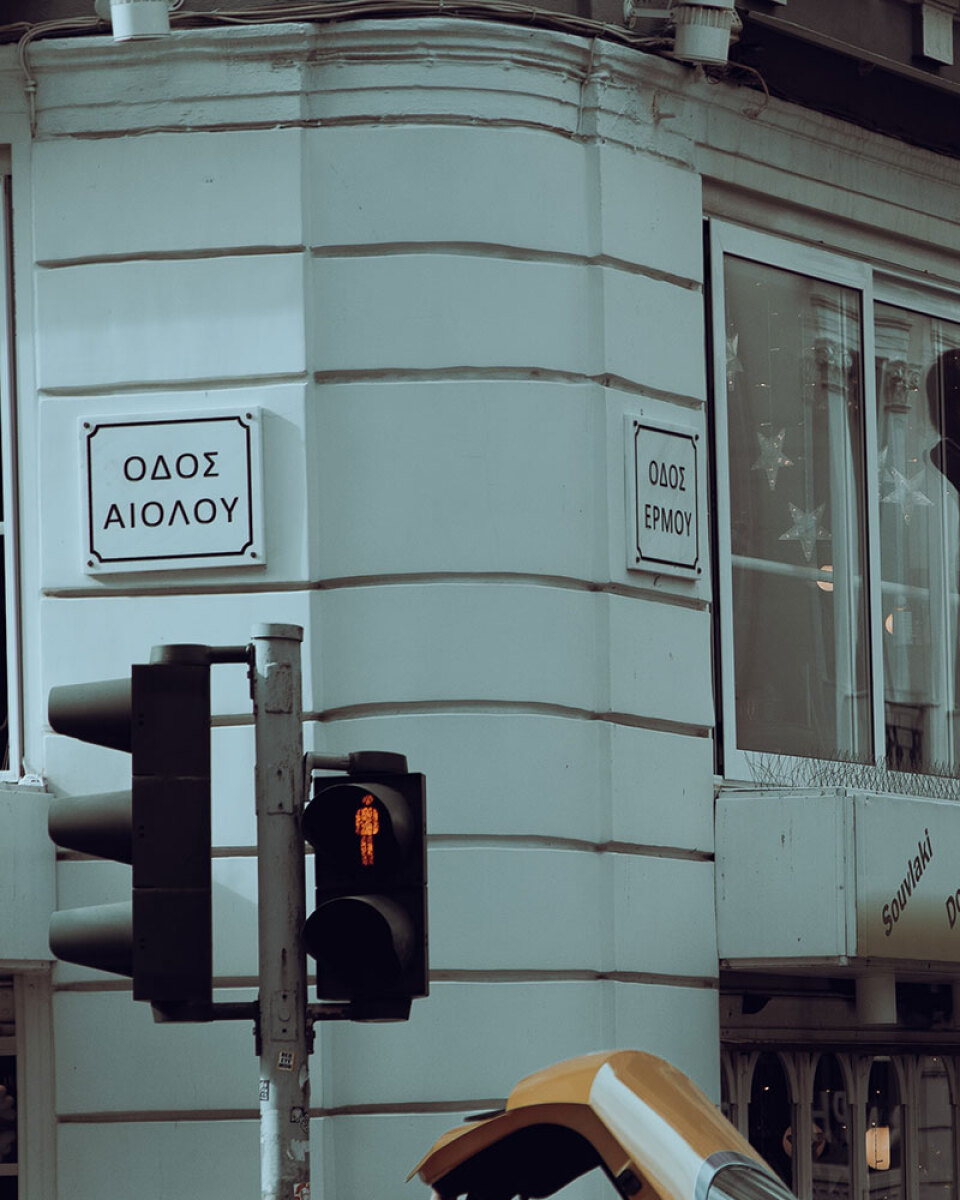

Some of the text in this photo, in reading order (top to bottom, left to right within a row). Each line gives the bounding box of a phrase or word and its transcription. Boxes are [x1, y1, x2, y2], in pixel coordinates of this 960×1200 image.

[123, 451, 219, 482] ΟΔΟΣ
[648, 460, 686, 492] ΟΔΟΣ
[103, 496, 239, 530] ΑΙΟΛΟΥ
[644, 504, 692, 537] ΕΡΜΟΥ
[882, 827, 933, 937] Souvlaki
